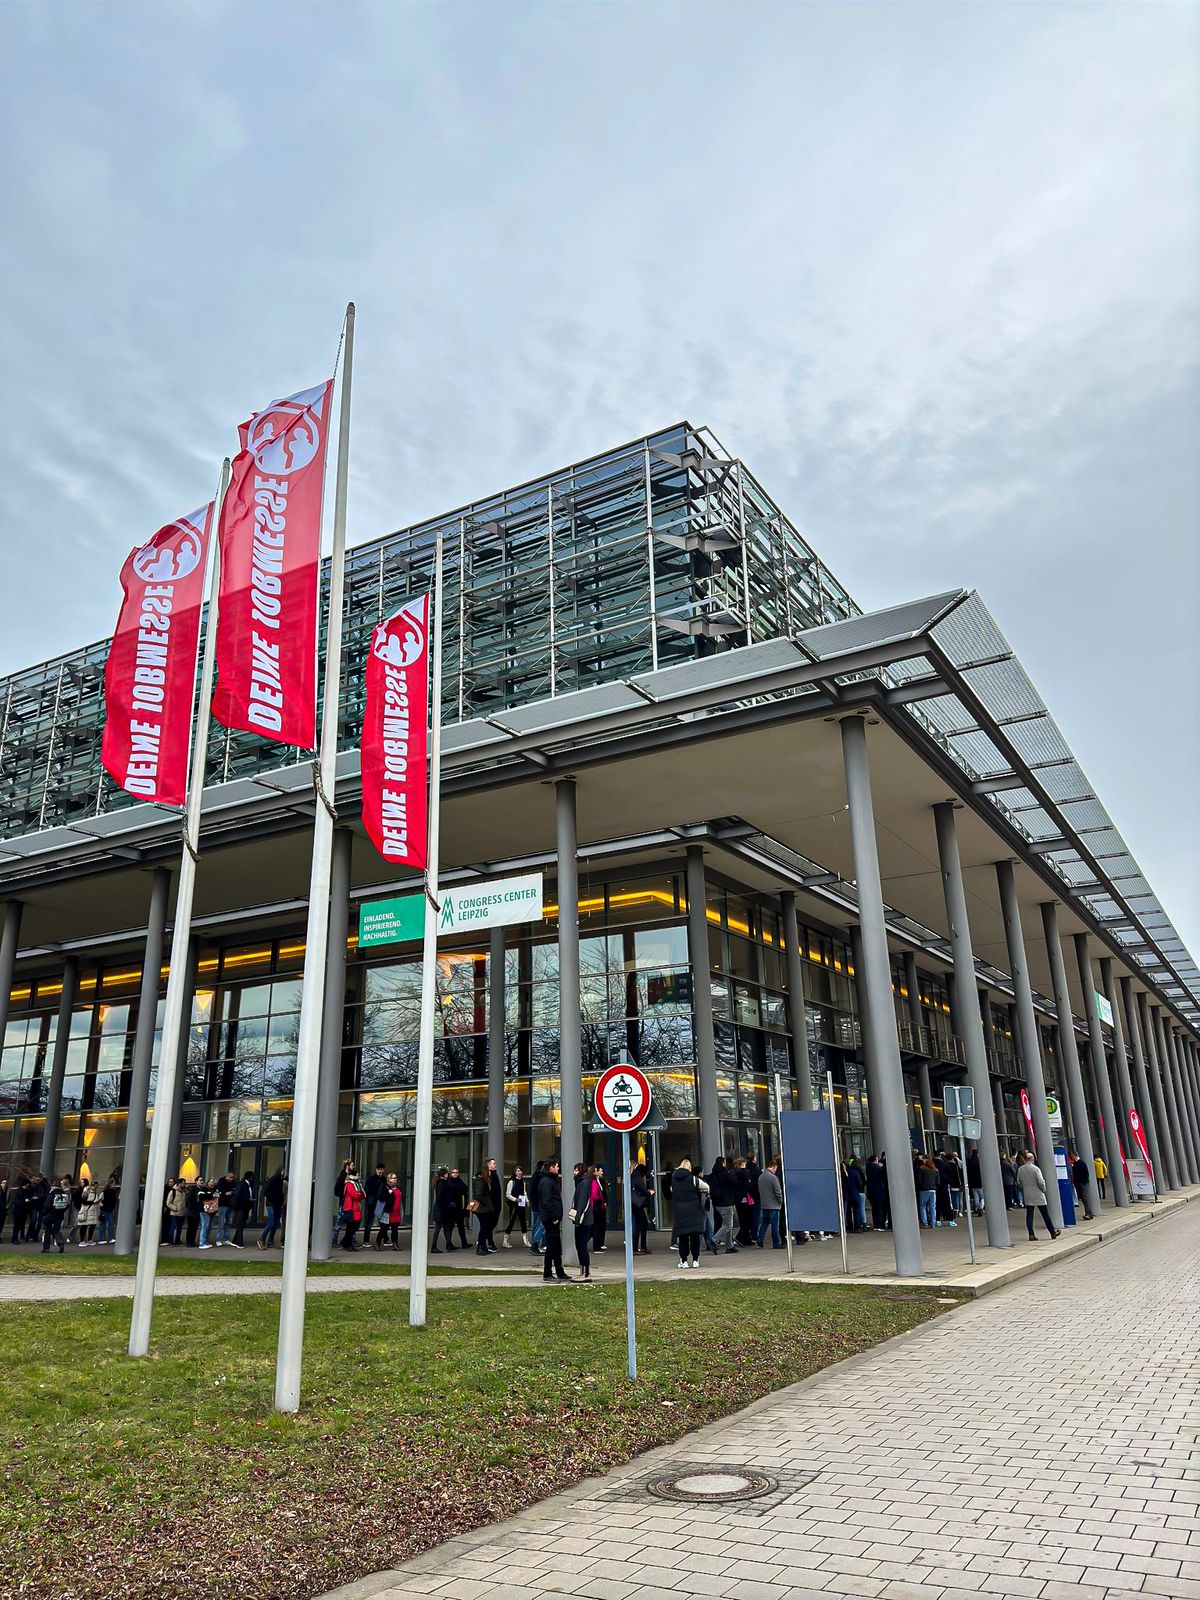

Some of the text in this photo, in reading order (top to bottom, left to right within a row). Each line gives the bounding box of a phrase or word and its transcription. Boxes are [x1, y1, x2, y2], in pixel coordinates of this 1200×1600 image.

[458, 888, 537, 910] CONGRESS CENTER
[364, 912, 396, 924] EINLADEND.
[458, 908, 489, 921] LEIPZIG
[363, 920, 403, 932] INSPIRIEREND.
[363, 929, 398, 941] NACHHALTIG.
